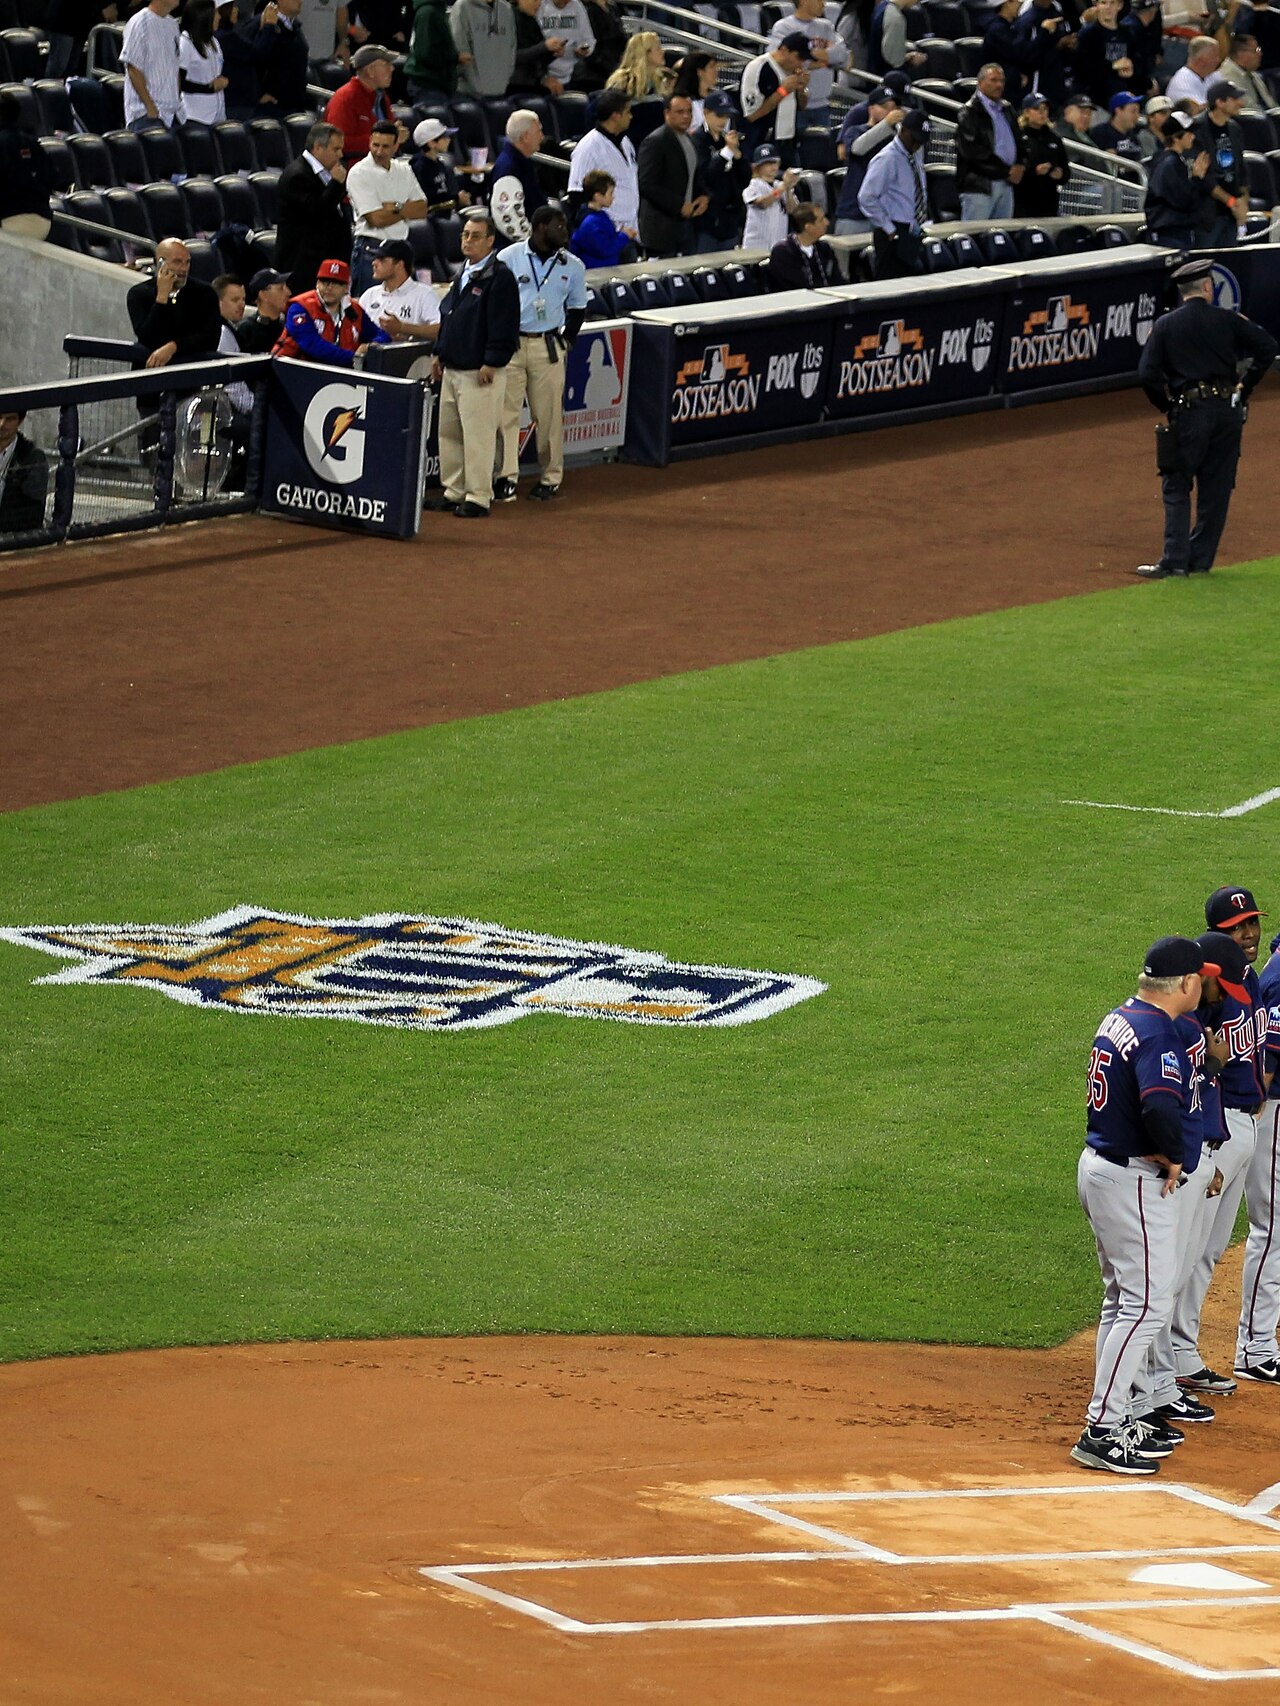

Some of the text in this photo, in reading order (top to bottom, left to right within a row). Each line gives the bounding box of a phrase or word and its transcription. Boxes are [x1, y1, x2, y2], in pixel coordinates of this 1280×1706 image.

[1104, 301, 1134, 341] FOX
[938, 327, 971, 366] FOX
[1007, 323, 1101, 373] POSTSEASON
[765, 352, 799, 392] FOX
[836, 349, 935, 398] POSTSEASON
[671, 374, 763, 423] OSTSEASON
[276, 483, 386, 522] GATORADE
